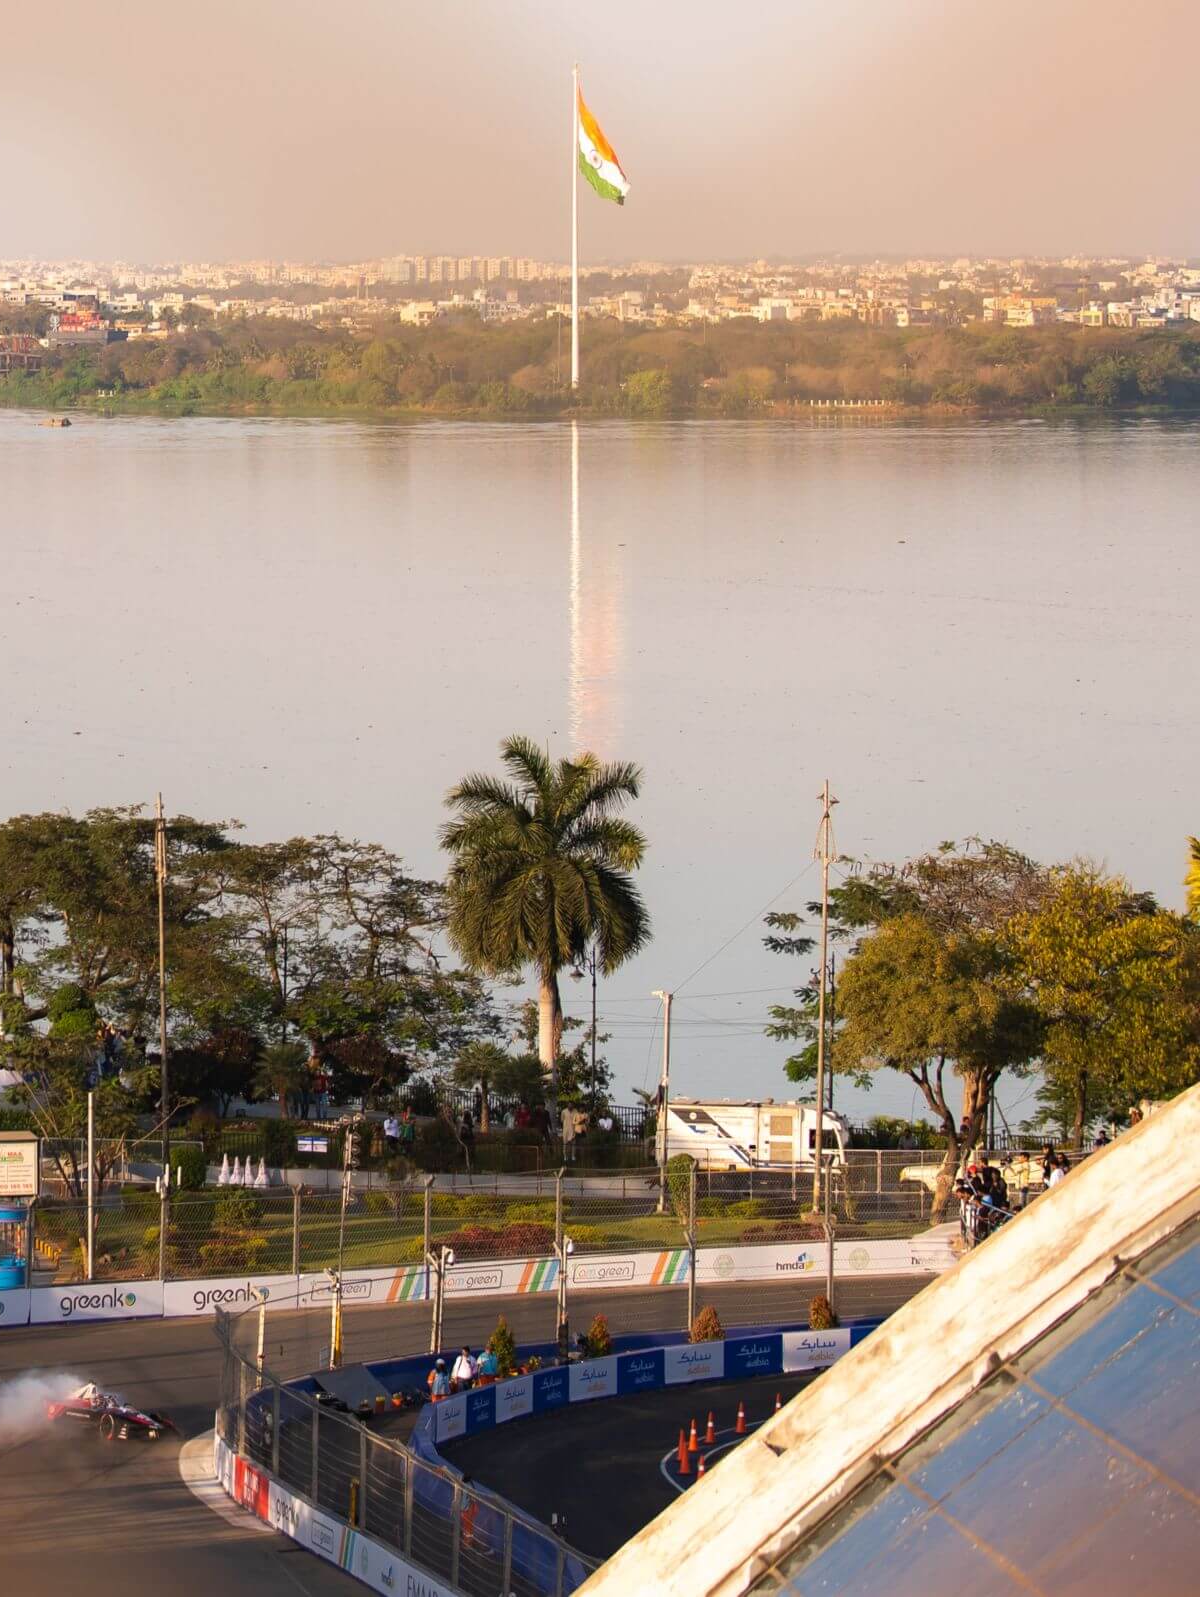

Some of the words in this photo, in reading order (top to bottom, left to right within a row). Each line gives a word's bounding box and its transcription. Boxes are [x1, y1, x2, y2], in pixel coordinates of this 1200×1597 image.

[597, 1266, 630, 1280] green
[776, 1261, 805, 1271] hmda
[466, 1275, 498, 1289] green
[60, 1287, 137, 1317] greenko
[193, 1281, 270, 1311] greenko
[746, 1356, 770, 1368] sabic
[808, 1351, 835, 1362] sabic
[407, 1573, 439, 1597] EMA
